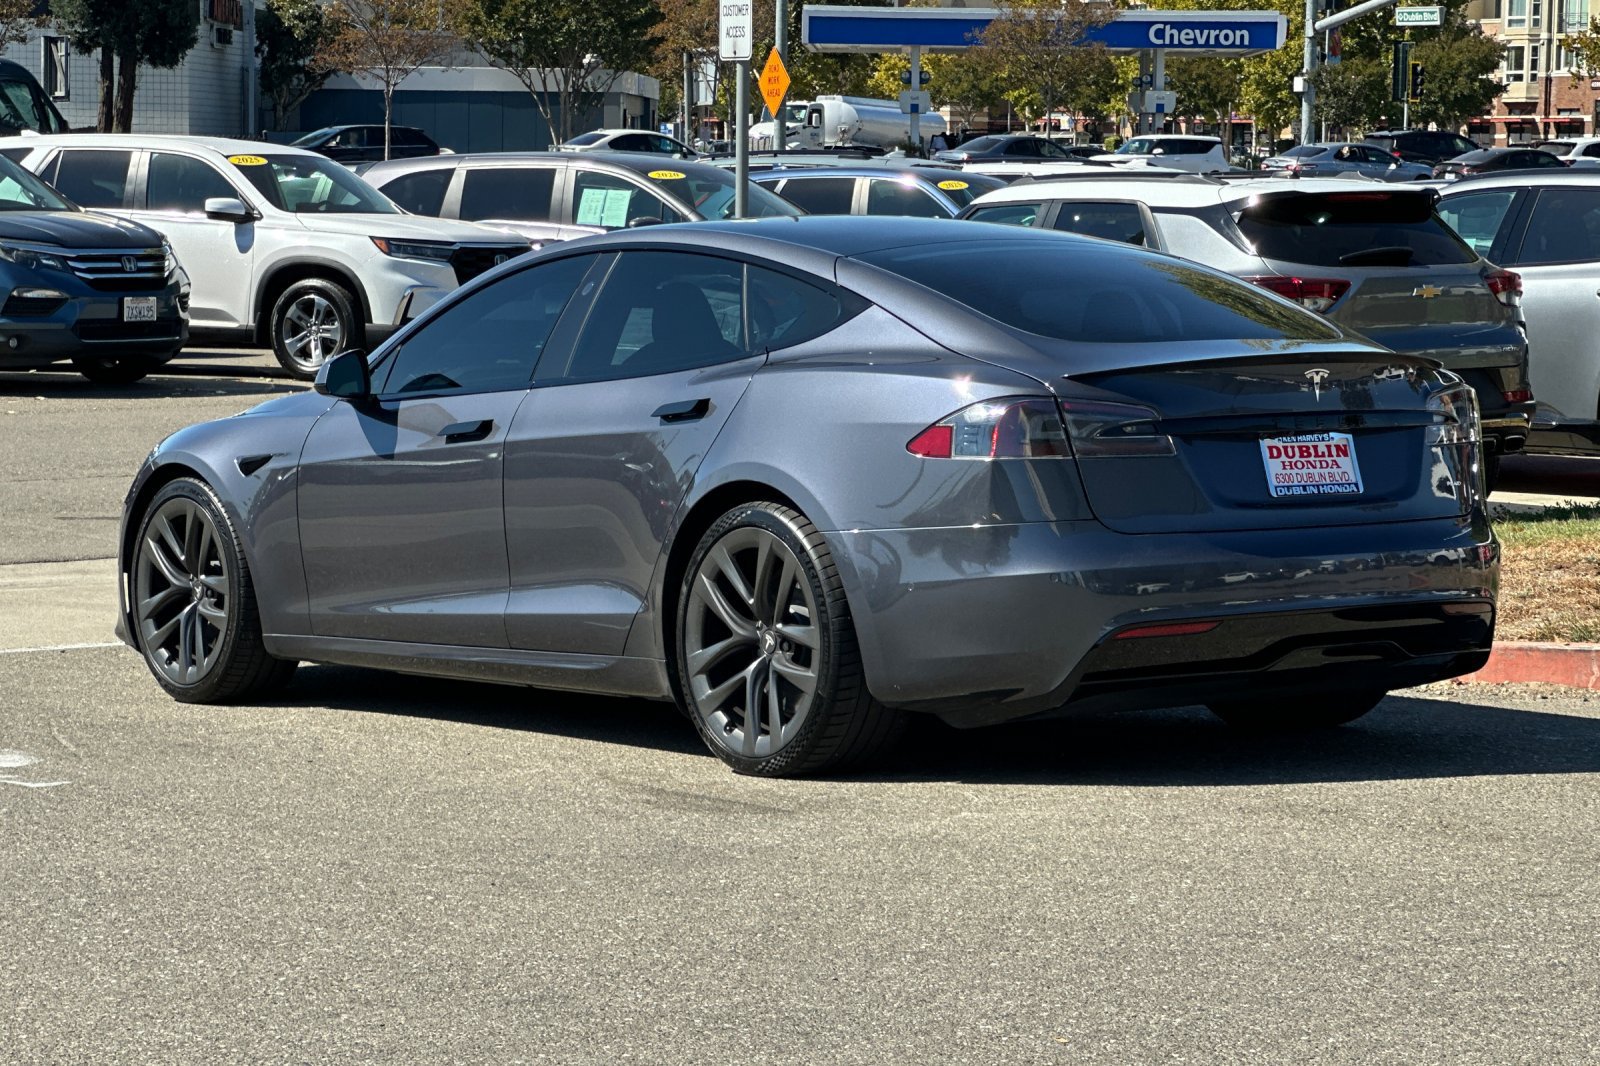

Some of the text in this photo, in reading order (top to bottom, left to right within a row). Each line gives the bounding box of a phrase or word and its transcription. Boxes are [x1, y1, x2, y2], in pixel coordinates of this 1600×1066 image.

[722, 4, 749, 17] CUSTOMER
[1403, 12, 1438, 21] Dublin Blvd
[725, 26, 746, 38] ACCESS
[1148, 23, 1249, 46] Chevron
[235, 156, 260, 164] 2025
[1267, 444, 1350, 459] DUBLIN
[1280, 459, 1342, 471] HONDA
[1275, 471, 1353, 484] 6300 DUBLIN BLVD.
[1276, 483, 1358, 496] DUBLIN HONDA
